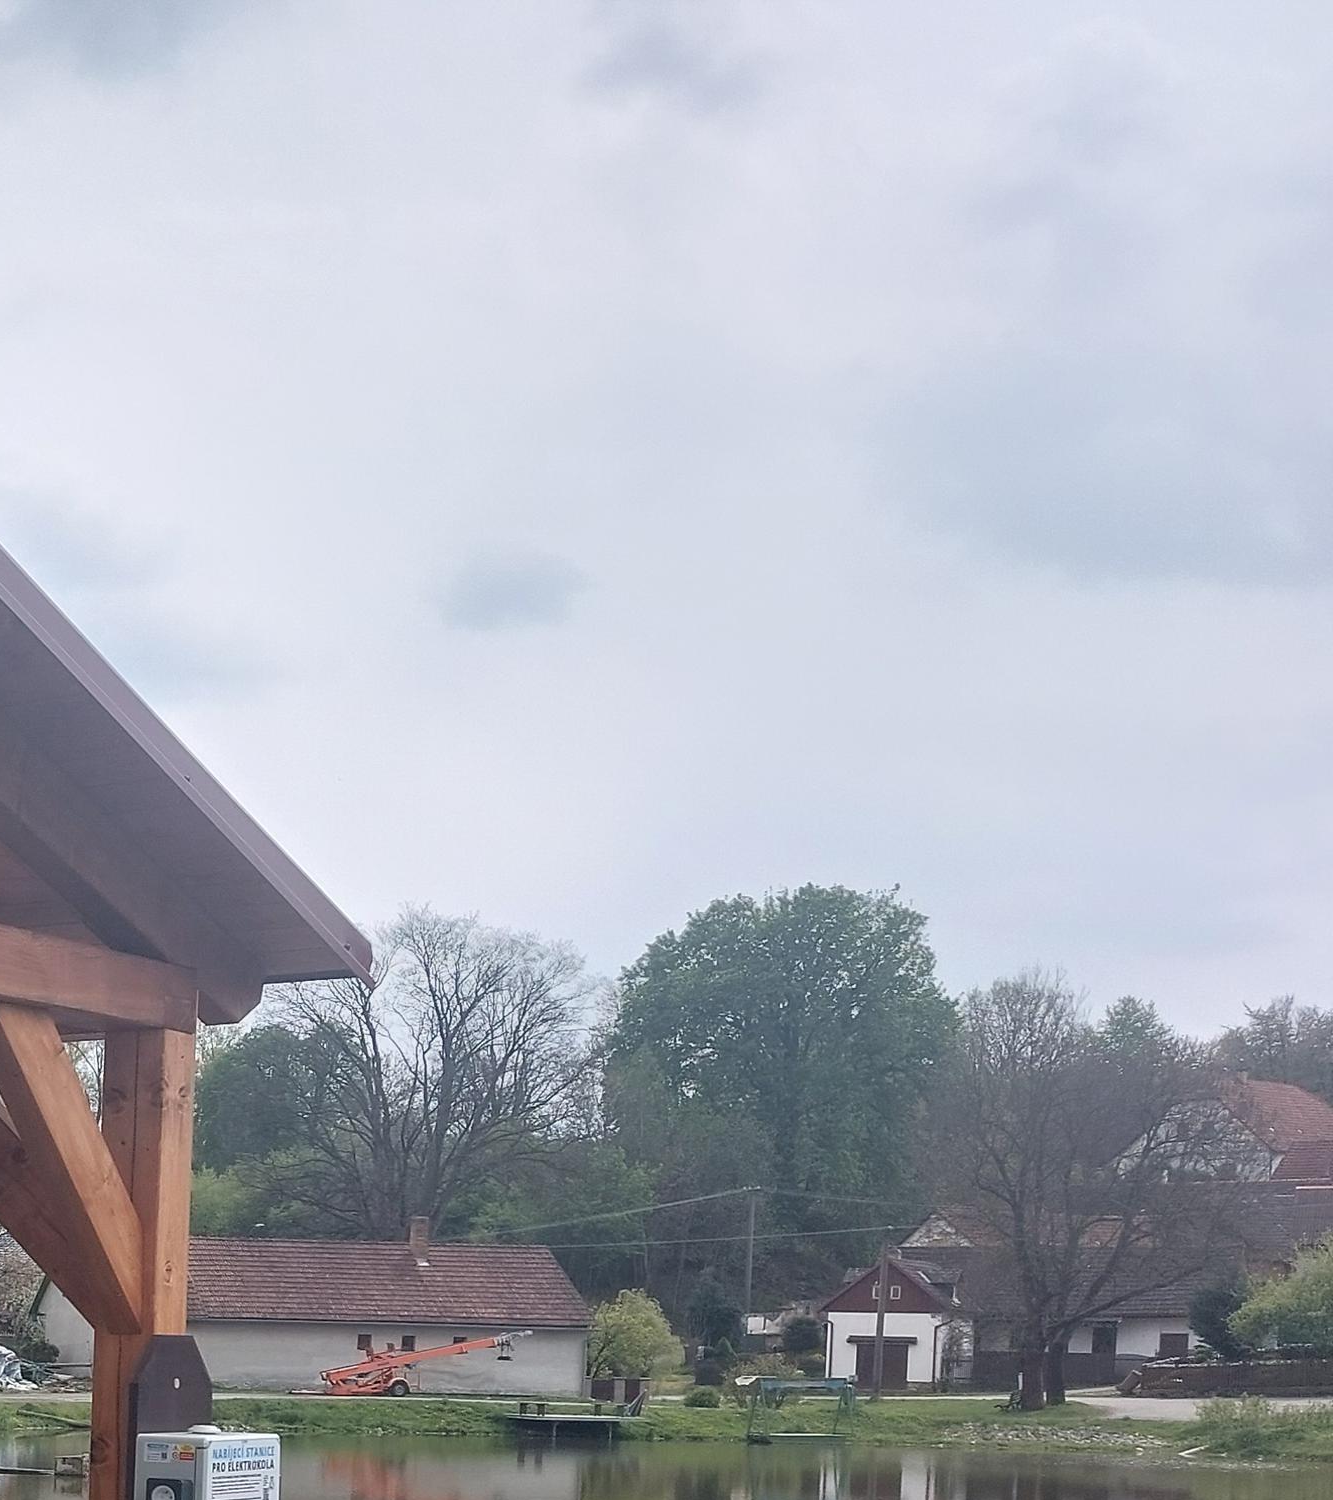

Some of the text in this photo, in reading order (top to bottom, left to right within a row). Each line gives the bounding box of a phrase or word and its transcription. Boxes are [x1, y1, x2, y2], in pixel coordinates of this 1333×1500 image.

[213, 1445, 274, 1460] NABÍJECÍ STANICE
[212, 1460, 274, 1473] PRO ELEKTROKOLA
